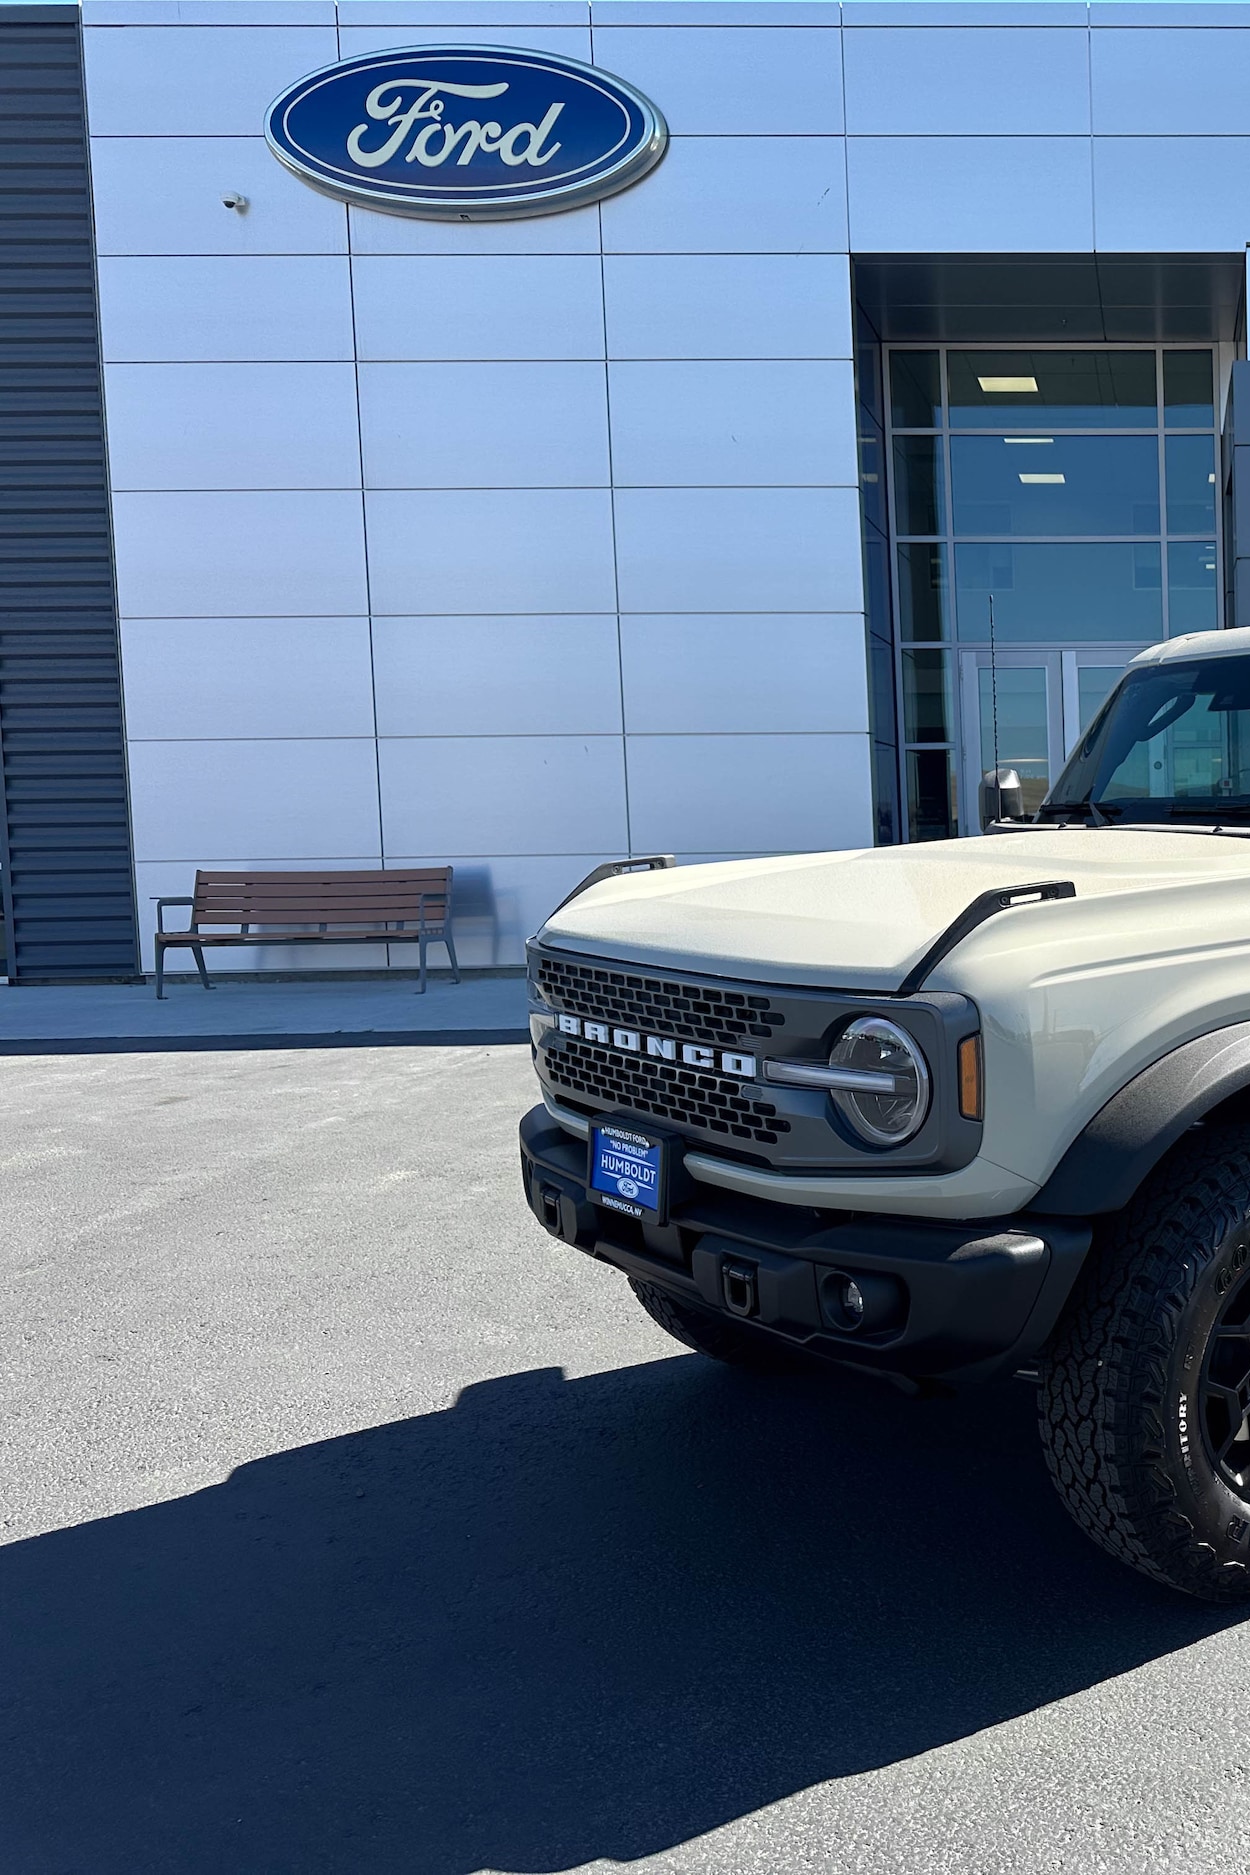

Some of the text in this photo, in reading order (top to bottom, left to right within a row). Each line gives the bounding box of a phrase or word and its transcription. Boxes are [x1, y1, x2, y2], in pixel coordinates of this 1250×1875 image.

[347, 78, 566, 168] Ford
[558, 1013, 757, 1078] BRONCO
[605, 1126, 632, 1141] HUMBOLDT
[601, 1154, 656, 1184] HUMBOLDT
